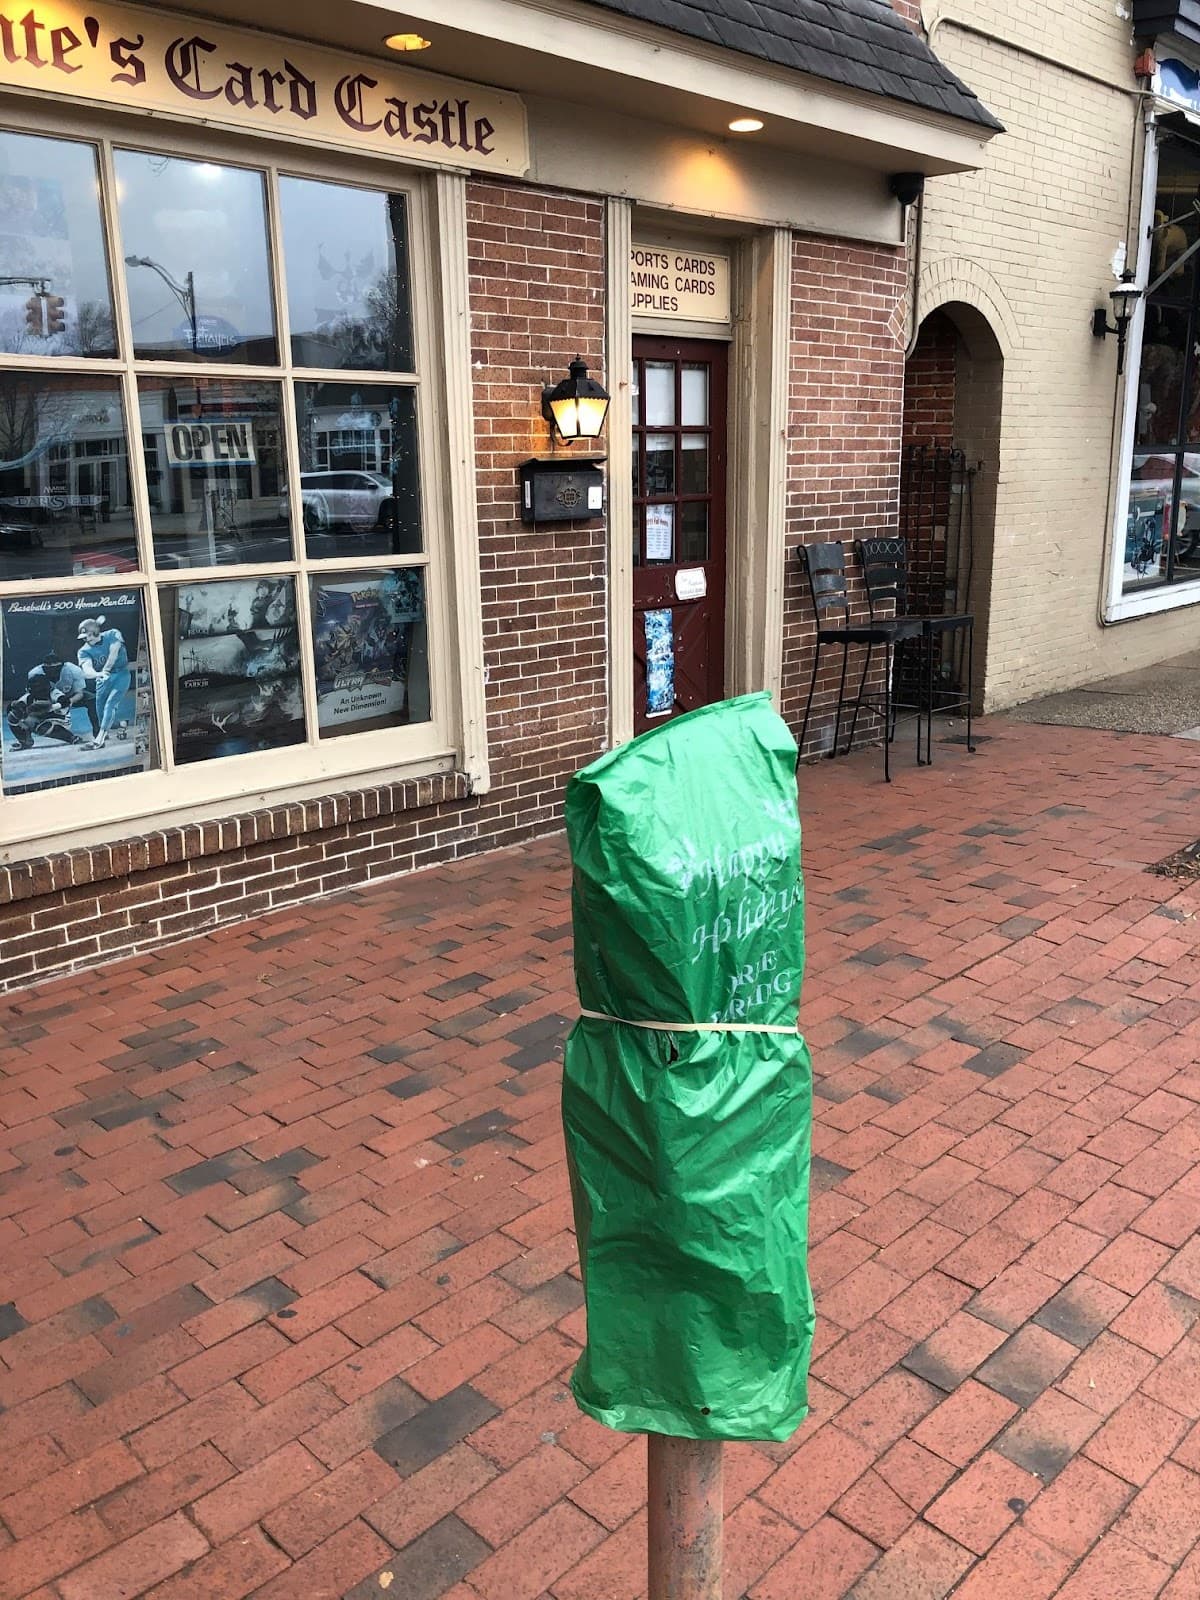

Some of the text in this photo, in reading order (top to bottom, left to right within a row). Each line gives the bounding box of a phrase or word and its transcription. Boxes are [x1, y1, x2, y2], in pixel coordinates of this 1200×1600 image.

[165, 36, 317, 120] Card
[334, 73, 496, 156] Castle
[675, 256, 716, 276] CARDS
[675, 277, 716, 296] CARDS
[172, 424, 249, 461] OPEN
[8, 595, 136, 613] Baseball's 500 Home Run Club
[333, 699, 387, 715] New Dimension!
[340, 692, 382, 705] An Unknown
